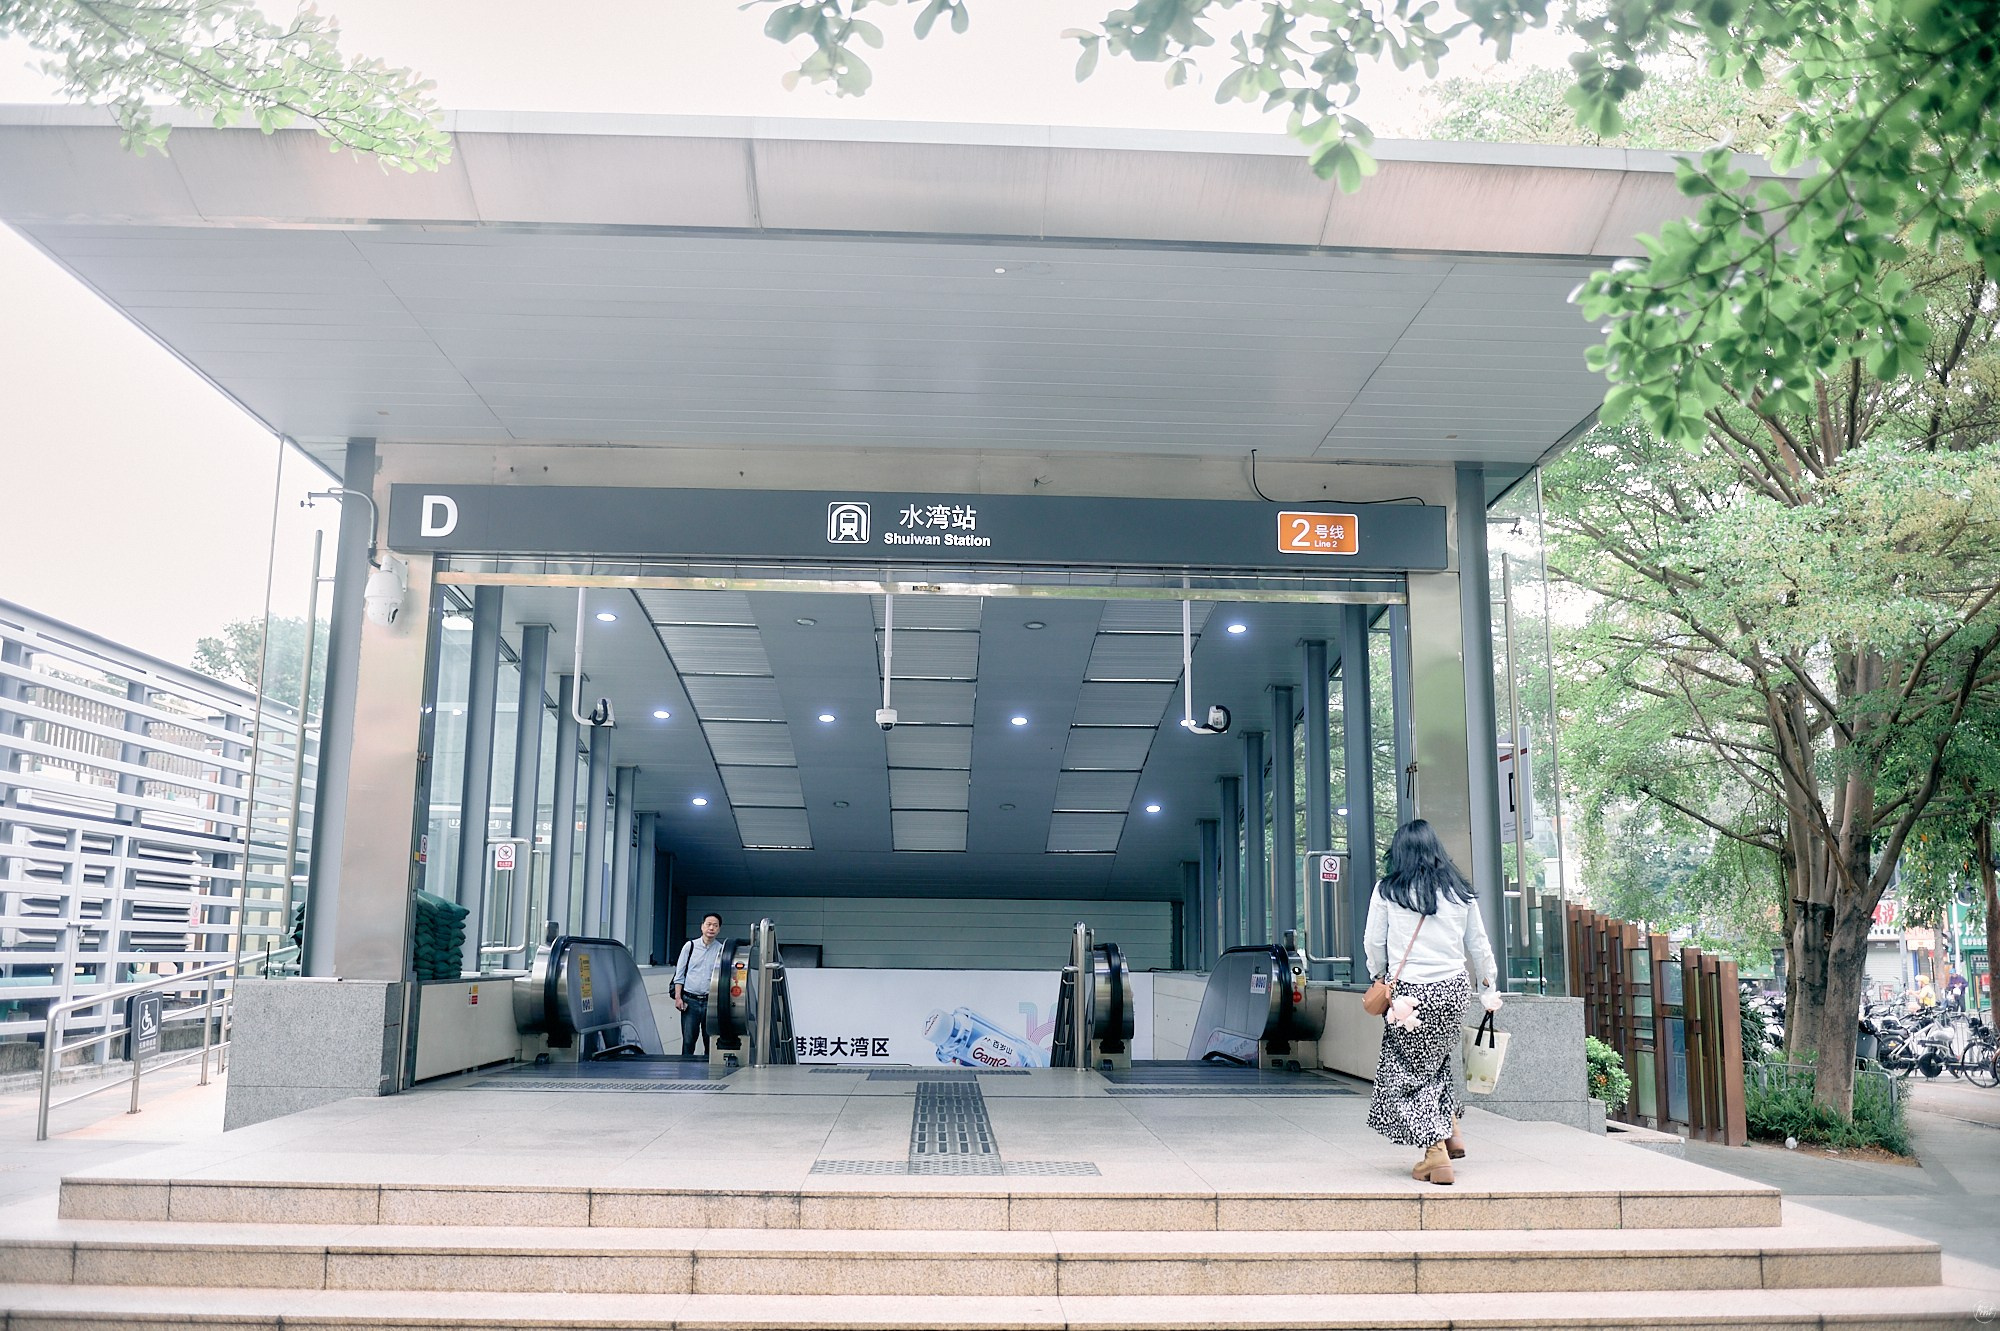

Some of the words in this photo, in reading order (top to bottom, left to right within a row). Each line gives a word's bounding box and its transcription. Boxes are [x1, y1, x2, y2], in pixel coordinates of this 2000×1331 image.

[421, 495, 458, 537] D
[899, 504, 977, 531] 水湾站
[883, 532, 940, 546] Shuiwan
[943, 534, 991, 548] Station
[1291, 518, 1311, 547] 2
[1314, 524, 1345, 540] 号线
[1314, 540, 1331, 548] Line
[1332, 540, 1338, 548] 2
[992, 1039, 1014, 1056] 百岁山
